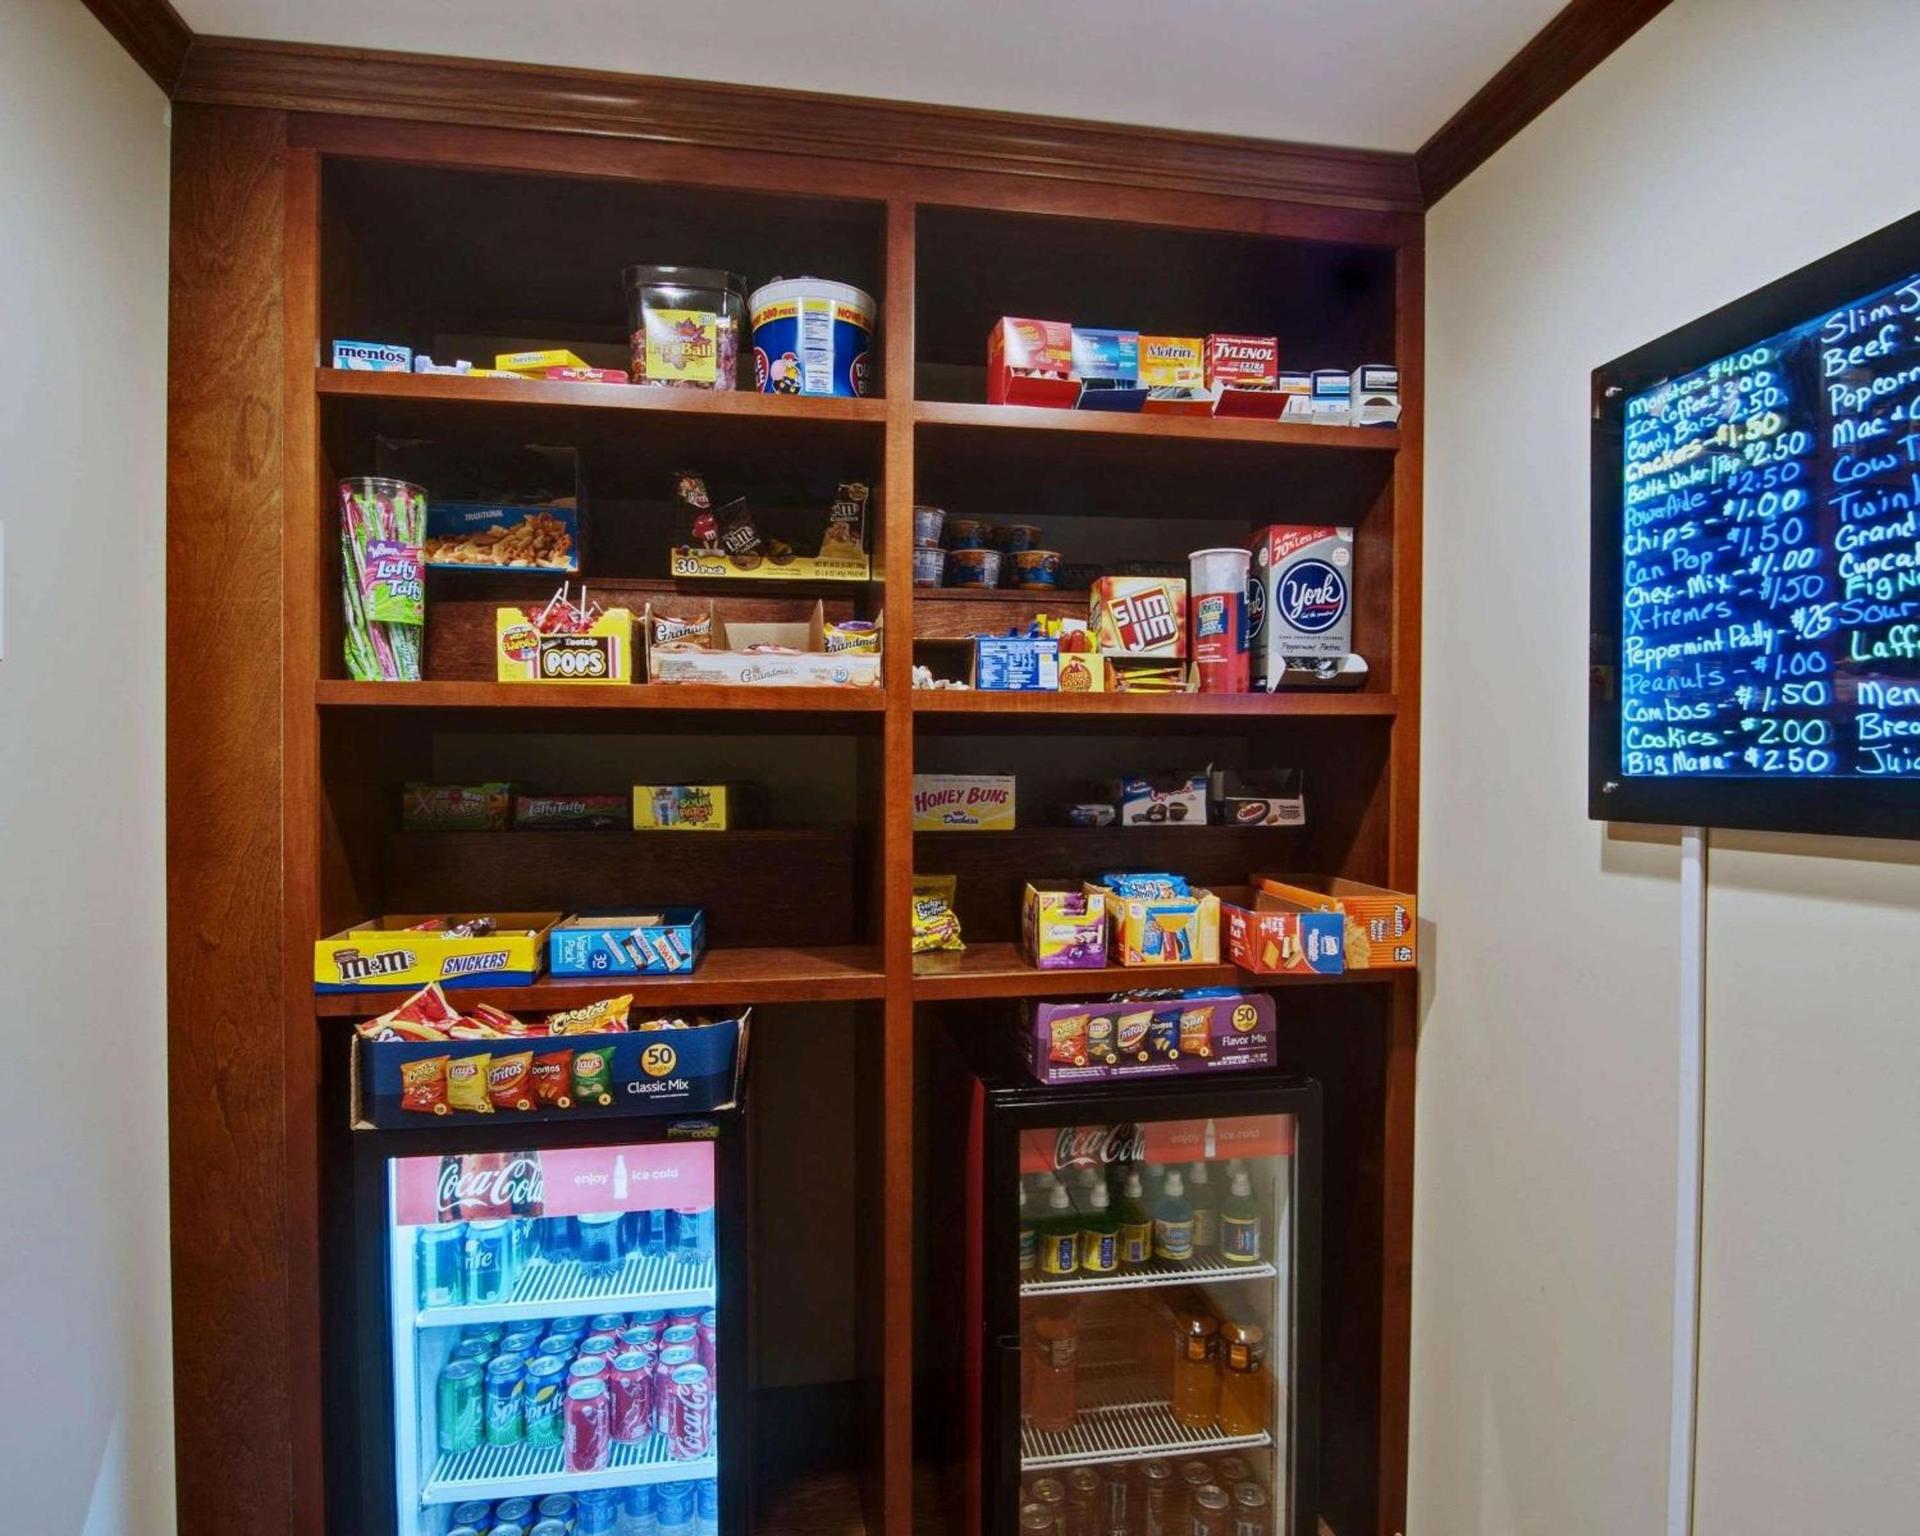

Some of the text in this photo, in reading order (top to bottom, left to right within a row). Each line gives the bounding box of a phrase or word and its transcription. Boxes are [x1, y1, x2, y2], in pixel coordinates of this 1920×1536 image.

[1820, 304, 1894, 344] Slim
[338, 346, 407, 363] mentos
[1148, 344, 1192, 358] Motrin
[1215, 343, 1274, 361] TYLENOL
[1708, 347, 1769, 382] $4.00
[1822, 323, 1897, 378] Beef
[1626, 417, 1659, 441] Ice
[1627, 431, 1672, 461] Candy
[1673, 412, 1718, 444] Bars
[1832, 417, 1888, 449] Mac
[1626, 438, 1703, 482] Crackers
[1744, 430, 1806, 467] $2.50
[1727, 461, 1800, 495] $2.50
[1832, 453, 1898, 483] Cow
[465, 509, 503, 521] TRADITIONAL
[1722, 488, 1801, 523] $1.00
[676, 558, 699, 573] 30
[1625, 517, 1803, 588] Can Pop $1.50
[376, 559, 417, 581] Laffy
[386, 579, 422, 601] Taffy
[1286, 573, 1342, 619] York
[1845, 573, 1893, 601] Fig
[1839, 597, 1920, 625] Sour
[1851, 623, 1920, 661] Laff
[546, 651, 602, 674] POPS
[1627, 650, 1828, 695] Peanuts $1.00
[1624, 680, 1827, 722] Combos $1.50
[1626, 716, 1827, 750] Cookies $2.00
[1627, 750, 1669, 776] Big
[1743, 746, 1829, 773] $2.50
[914, 786, 1009, 812] HONEY BUNS
[1394, 903, 1406, 937] Austin
[443, 953, 507, 973] SNICKERS
[593, 953, 608, 969] 30
[1070, 949, 1084, 958] Fig
[1400, 947, 1412, 961] 45
[1236, 1007, 1255, 1022] 50
[1222, 1033, 1267, 1047] Flavor Mix
[647, 1047, 673, 1066] 50
[627, 1078, 690, 1094] Classic Mix
[1054, 1122, 1146, 1170] Coca-Cola
[1170, 1133, 1201, 1146] enjoy
[1237, 1128, 1260, 1140] cold
[437, 1158, 679, 1212] Coca-Cola enjoy ice cold
